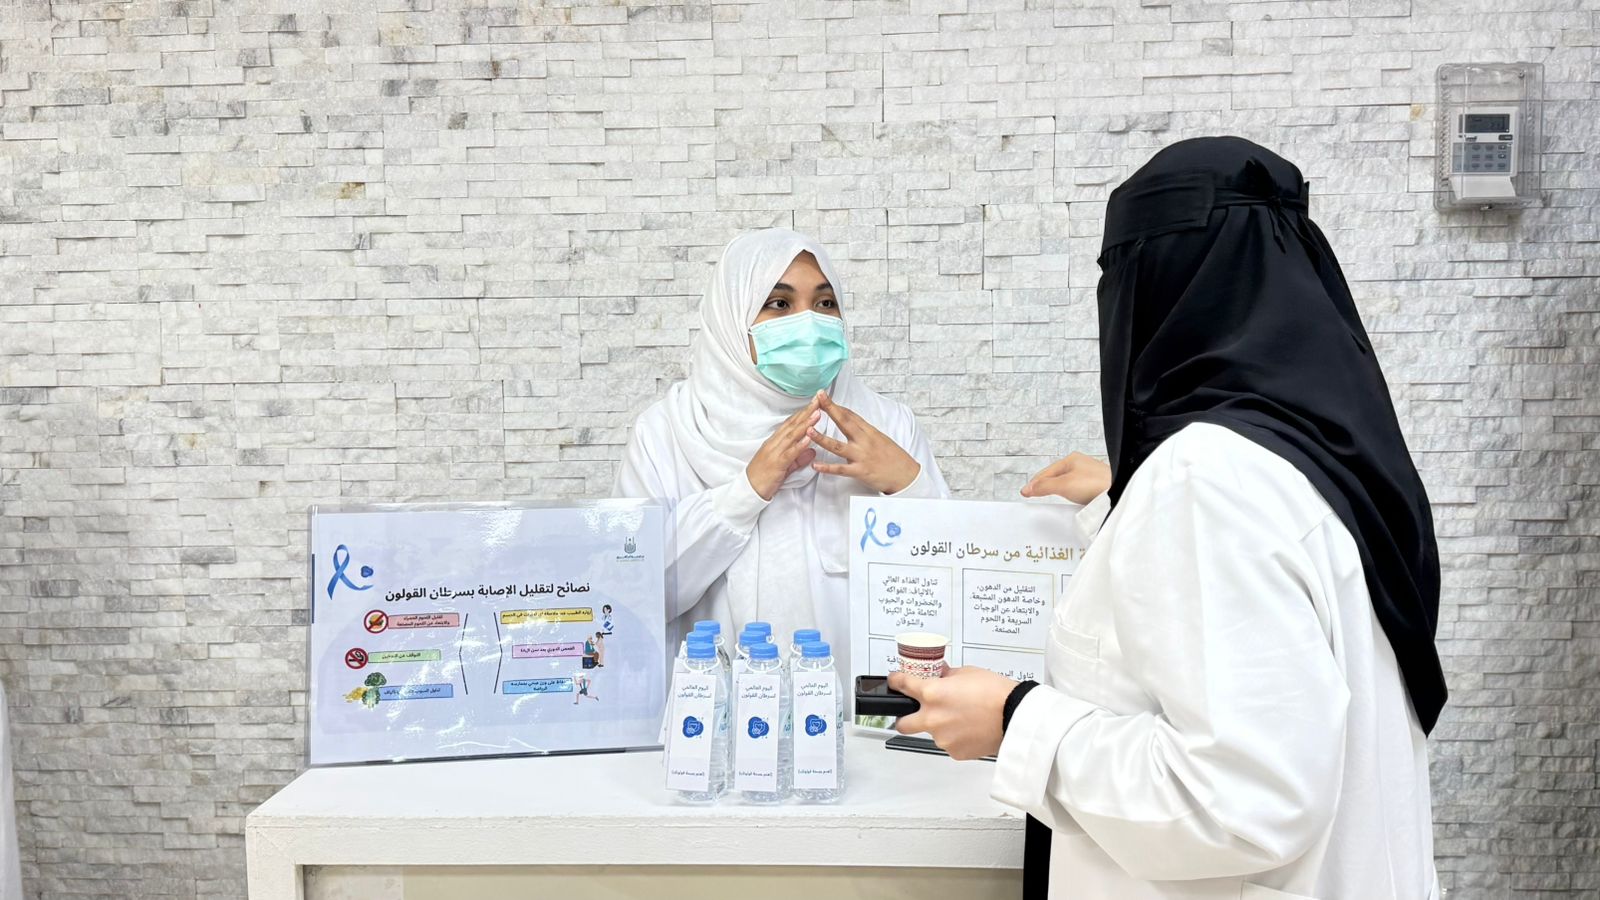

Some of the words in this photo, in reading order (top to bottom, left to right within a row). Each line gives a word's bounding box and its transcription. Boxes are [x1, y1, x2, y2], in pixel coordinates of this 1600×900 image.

[910, 540, 952, 556] القولون
[956, 542, 998, 559] سرطان
[1003, 550, 1020, 562] من
[1026, 545, 1073, 562] الغذائية
[882, 576, 899, 586] العالي
[921, 578, 938, 587] تناول
[430, 587, 475, 600] بسرطان
[478, 584, 516, 599] الإصابة
[519, 583, 554, 598] لتقليل
[556, 582, 590, 598] نصائح
[1014, 585, 1036, 594] التقليل
[385, 588, 426, 602] القولون
[998, 596, 1019, 604] الدهون
[906, 598, 942, 608] والخضروات
[1022, 596, 1045, 606] وخاصة
[883, 606, 902, 615] الكينوا
[904, 607, 915, 616] مثل
[974, 604, 998, 613] الوجبات
[981, 616, 1005, 624] واللحوم
[1007, 616, 1032, 626] السريعة
